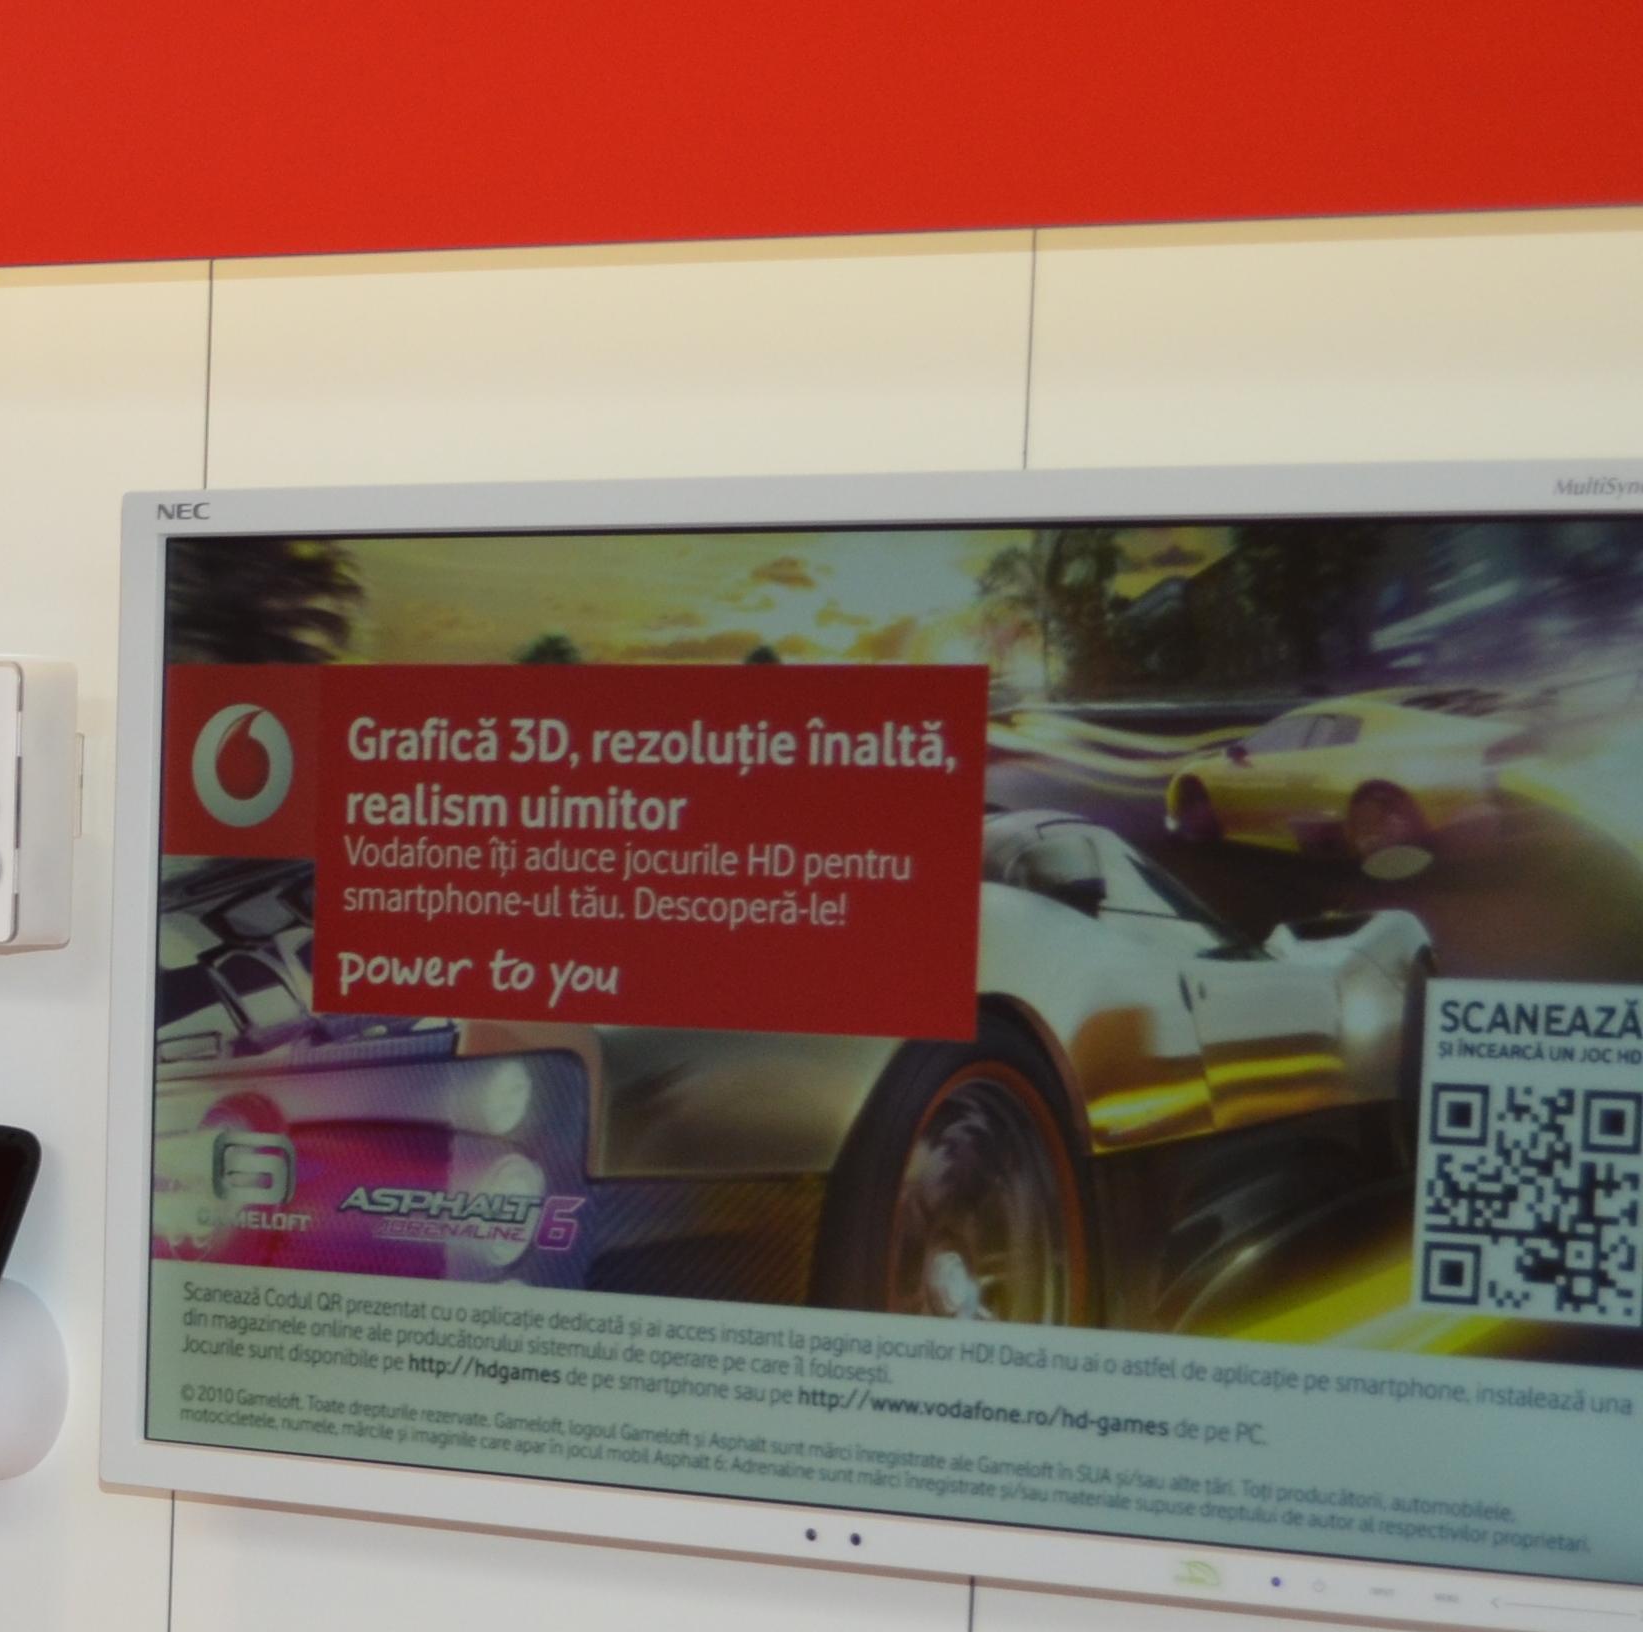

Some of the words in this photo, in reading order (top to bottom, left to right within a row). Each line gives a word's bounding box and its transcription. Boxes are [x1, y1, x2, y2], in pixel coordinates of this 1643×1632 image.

[157, 502, 211, 520] NEC
[348, 716, 500, 763] Grafică
[510, 718, 580, 768] 3D,
[592, 720, 797, 776] rezoluție
[808, 717, 957, 774] înaltă,
[346, 783, 509, 827] realism
[521, 785, 689, 832] uimitor
[344, 835, 483, 871] Vodafone
[488, 836, 517, 879] îți
[524, 841, 616, 873] aduce
[622, 841, 739, 881] jocurile
[747, 844, 797, 877] HD
[804, 848, 913, 886] pentru
[343, 883, 560, 921] smartphone-ul
[569, 886, 625, 919] tău.
[634, 887, 848, 931] Descoperă-le!
[338, 950, 472, 995] power
[489, 948, 536, 992] to
[549, 957, 620, 1008] you
[1440, 998, 1643, 1041] SCANEAZĂ
[1458, 1038, 1545, 1061] ÎNCEARCĂ
[1549, 1046, 1575, 1063] UN
[1579, 1047, 1612, 1065] JOC
[339, 1185, 543, 1224] ASPHALT
[537, 1194, 586, 1251] 6
[182, 1305, 207, 1328] din
[212, 1312, 306, 1336] magazinele
[310, 1317, 362, 1341] online
[367, 1320, 392, 1343] ale
[526, 1335, 614, 1361] sistemului
[622, 1340, 644, 1364] de
[649, 1348, 717, 1371] operare
[721, 1354, 746, 1376] pe
[750, 1356, 789, 1376] care
[182, 1279, 260, 1306] Scanează
[265, 1285, 312, 1310] Codul
[317, 1289, 342, 1313] QR
[345, 1296, 425, 1319] prezentat
[430, 1303, 451, 1321] cu
[455, 1305, 466, 1322] o
[471, 1303, 543, 1332] aplicație
[547, 1307, 623, 1335] dedicată
[645, 1317, 660, 1338] ai
[665, 1321, 715, 1342] acces
[720, 1322, 784, 1347] instant
[788, 1326, 804, 1349] la
[810, 1332, 871, 1357] pagina
[875, 1335, 954, 1361] jocurilor
[960, 1340, 995, 1364] HD!
[999, 1343, 1046, 1369] Dacă
[1051, 1352, 1077, 1371] nu
[1082, 1352, 1099, 1373] ai
[1103, 1357, 1115, 1374] o
[1120, 1356, 1176, 1379] astfel
[1182, 1358, 1207, 1382] de
[1213, 1363, 1298, 1393] aplicație
[1303, 1373, 1329, 1396] pe
[1335, 1376, 1469, 1405] smartphone,
[1475, 1384, 1585, 1413] instalează
[1590, 1397, 1632, 1417] una
[181, 1330, 244, 1357] Jocurile
[248, 1340, 283, 1360] sunt
[289, 1339, 380, 1369] disponibile
[382, 1352, 405, 1375] pe
[408, 1350, 560, 1384] http://hdgames
[565, 1363, 586, 1387] de
[591, 1370, 613, 1393] pe
[618, 1373, 729, 1400] smartphone
[733, 1383, 764, 1402] sau
[769, 1386, 792, 1408] pe
[1175, 1416, 1198, 1439] de
[1204, 1423, 1229, 1446] pe
